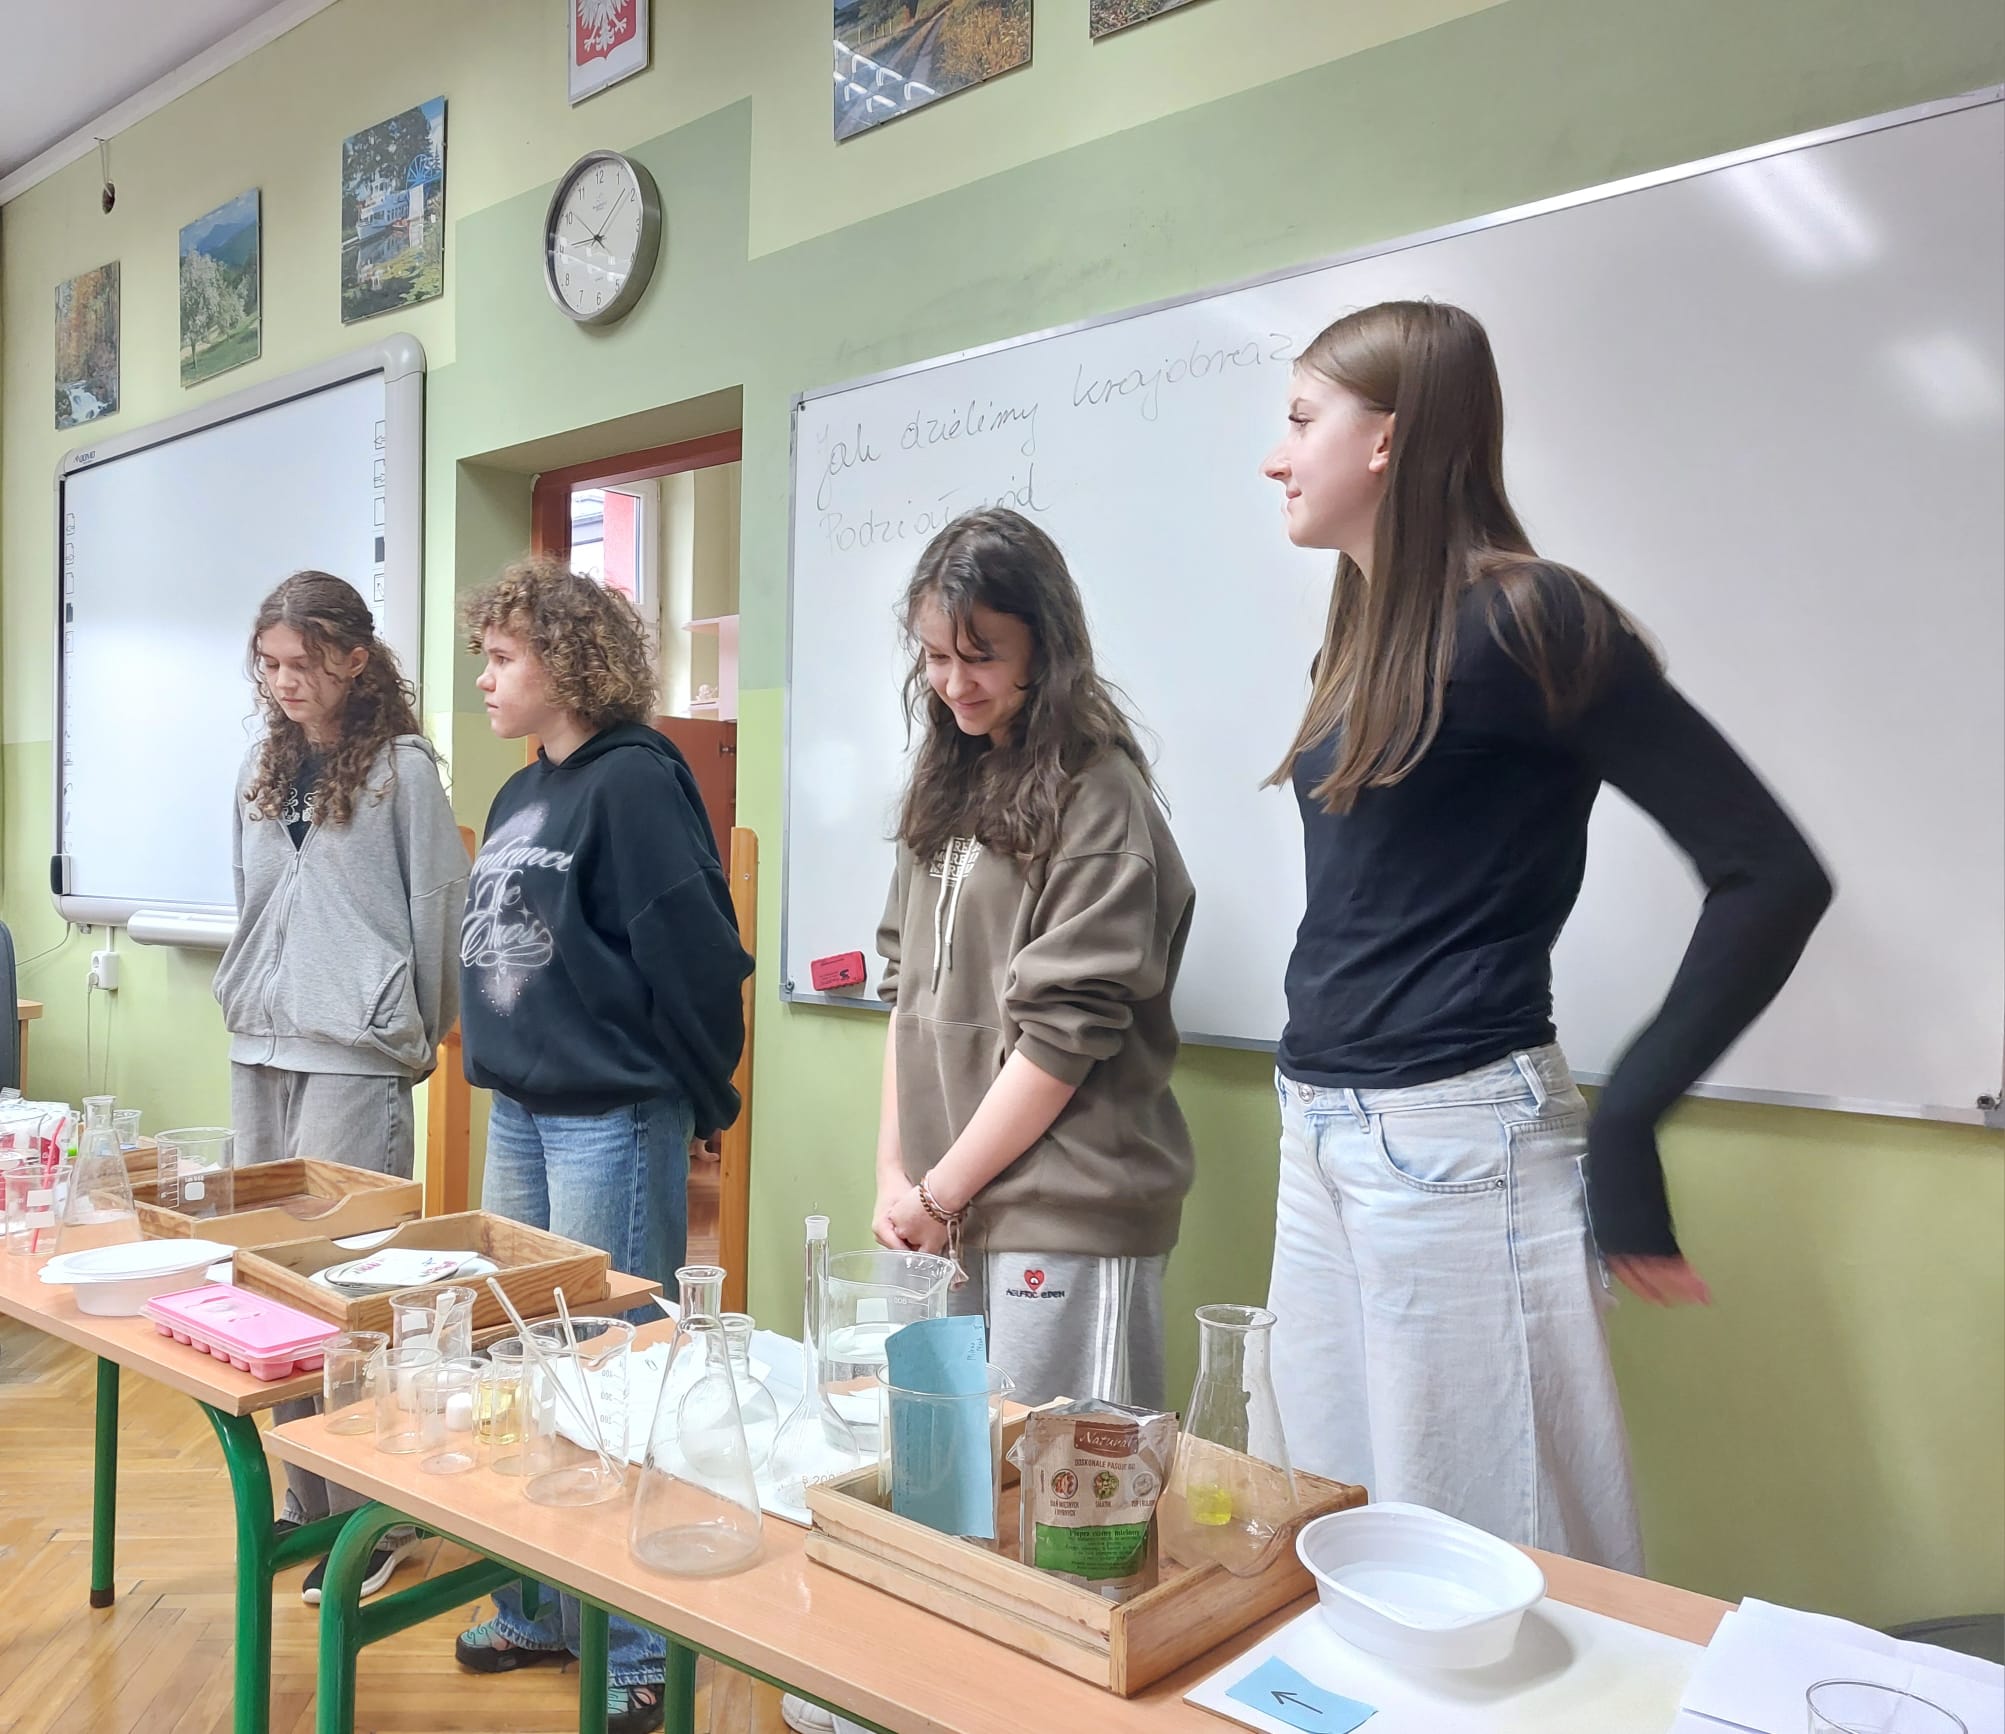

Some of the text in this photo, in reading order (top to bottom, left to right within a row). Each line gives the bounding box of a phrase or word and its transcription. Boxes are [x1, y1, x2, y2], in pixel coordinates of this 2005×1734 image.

[595, 170, 604, 184] 12
[577, 186, 585, 201] 11
[630, 187, 636, 202] 2
[564, 211, 573, 225] 10
[635, 218, 640, 233] 3
[565, 273, 570, 287] 8
[615, 279, 620, 292] 5
[578, 290, 584, 305] 7
[596, 292, 602, 305] 6
[900, 401, 1039, 456] dzielimy
[983, 462, 1053, 512] ód
